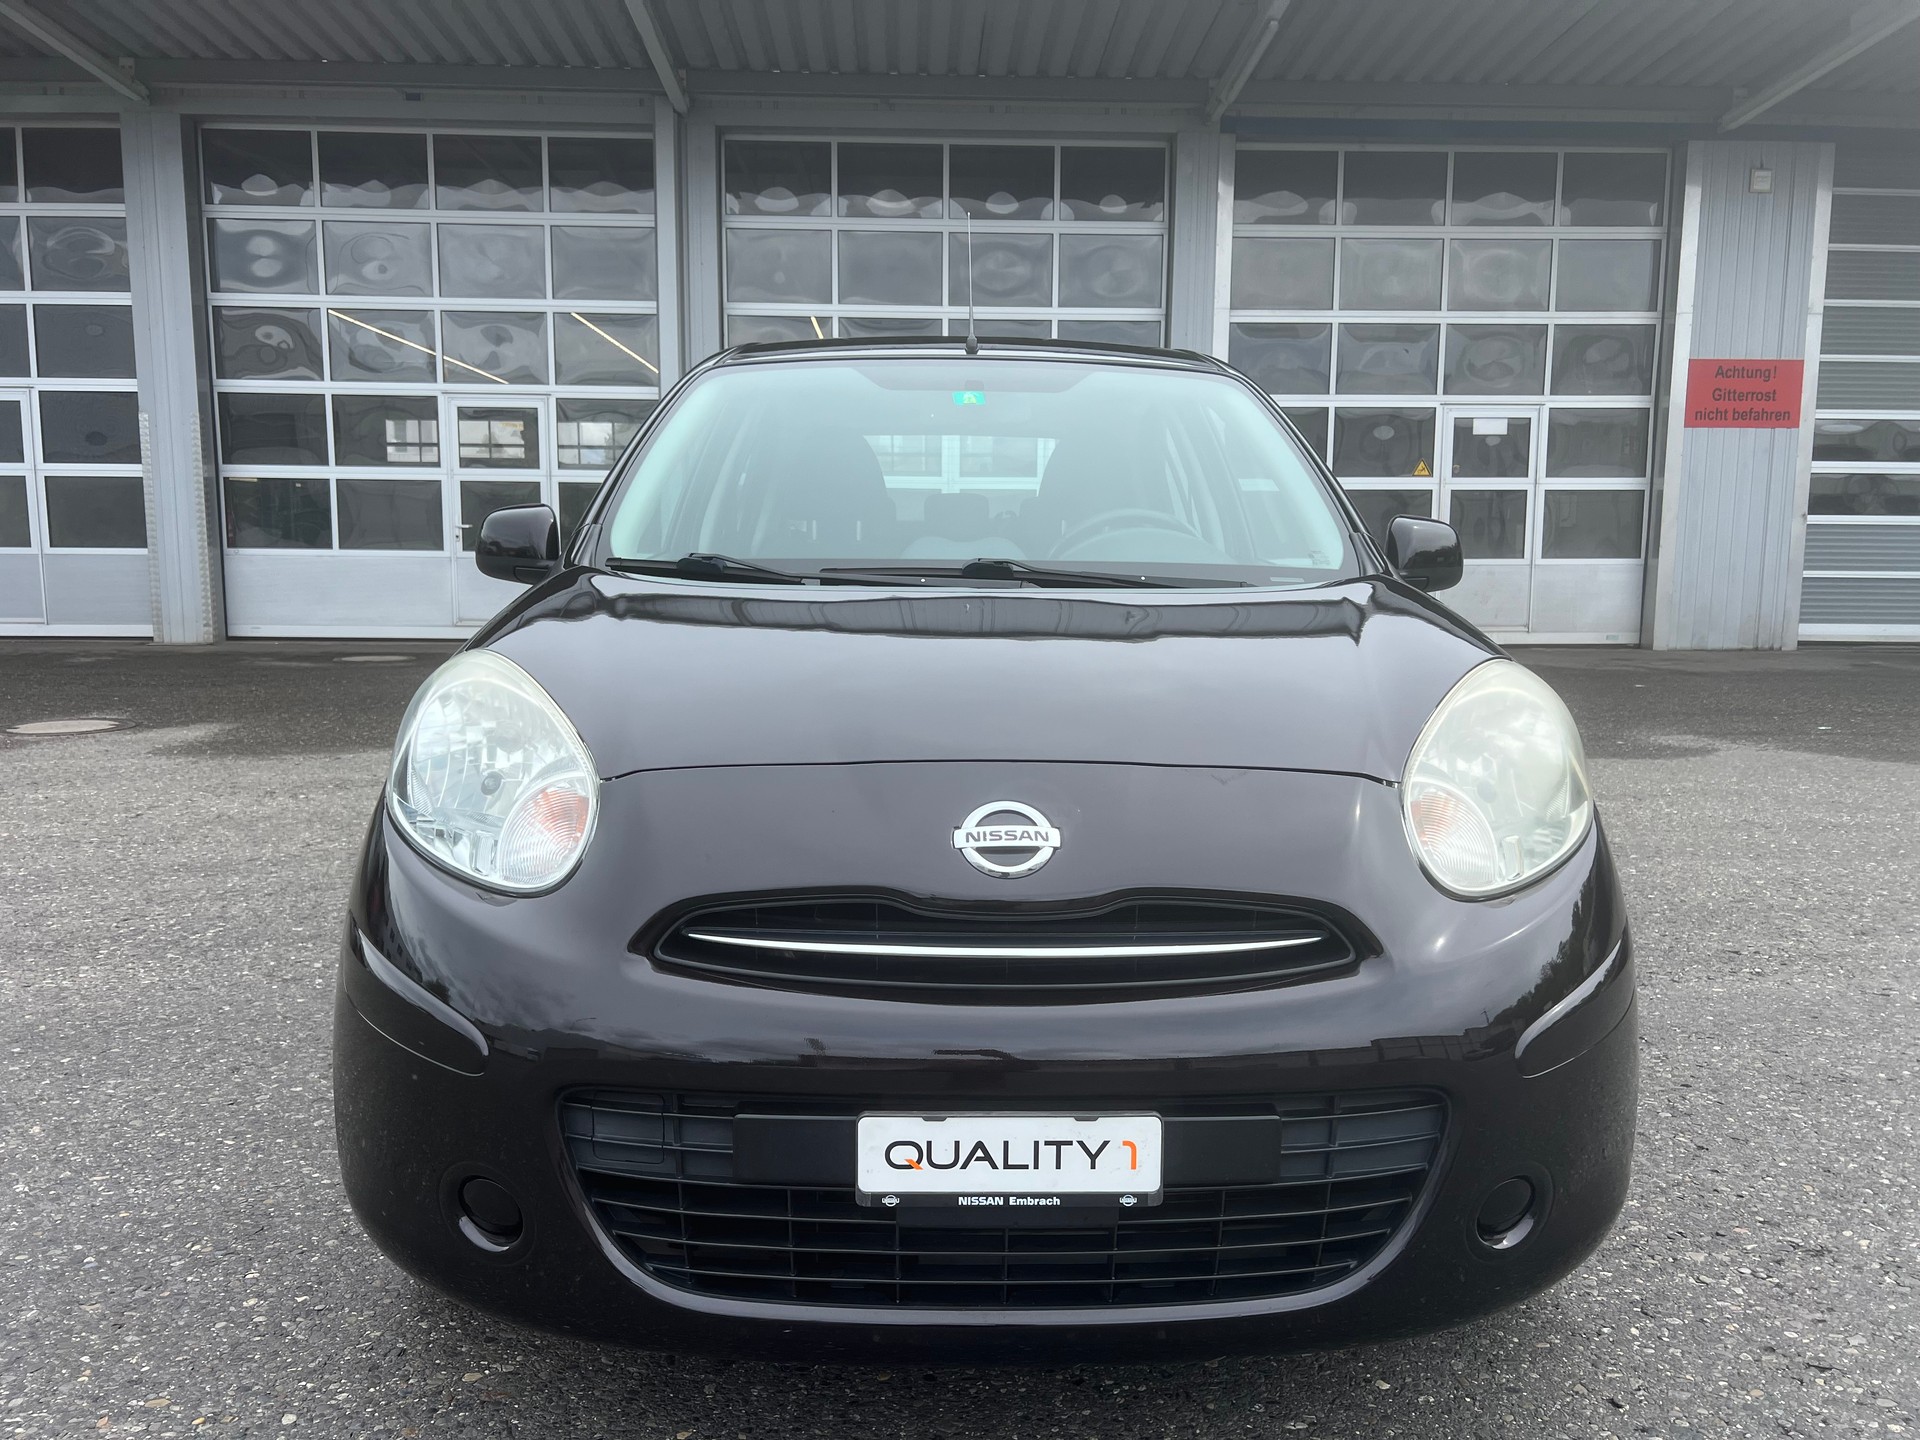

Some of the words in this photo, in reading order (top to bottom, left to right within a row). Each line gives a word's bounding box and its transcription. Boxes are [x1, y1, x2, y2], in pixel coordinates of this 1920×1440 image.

[1711, 387, 1777, 402] Gitterrost
[1694, 407, 1729, 421] nicht
[1731, 407, 1791, 421] befahren
[965, 830, 1050, 843] NISSAN
[958, 1196, 1004, 1206] NISSAN
[1008, 1196, 1061, 1206] Embrach
